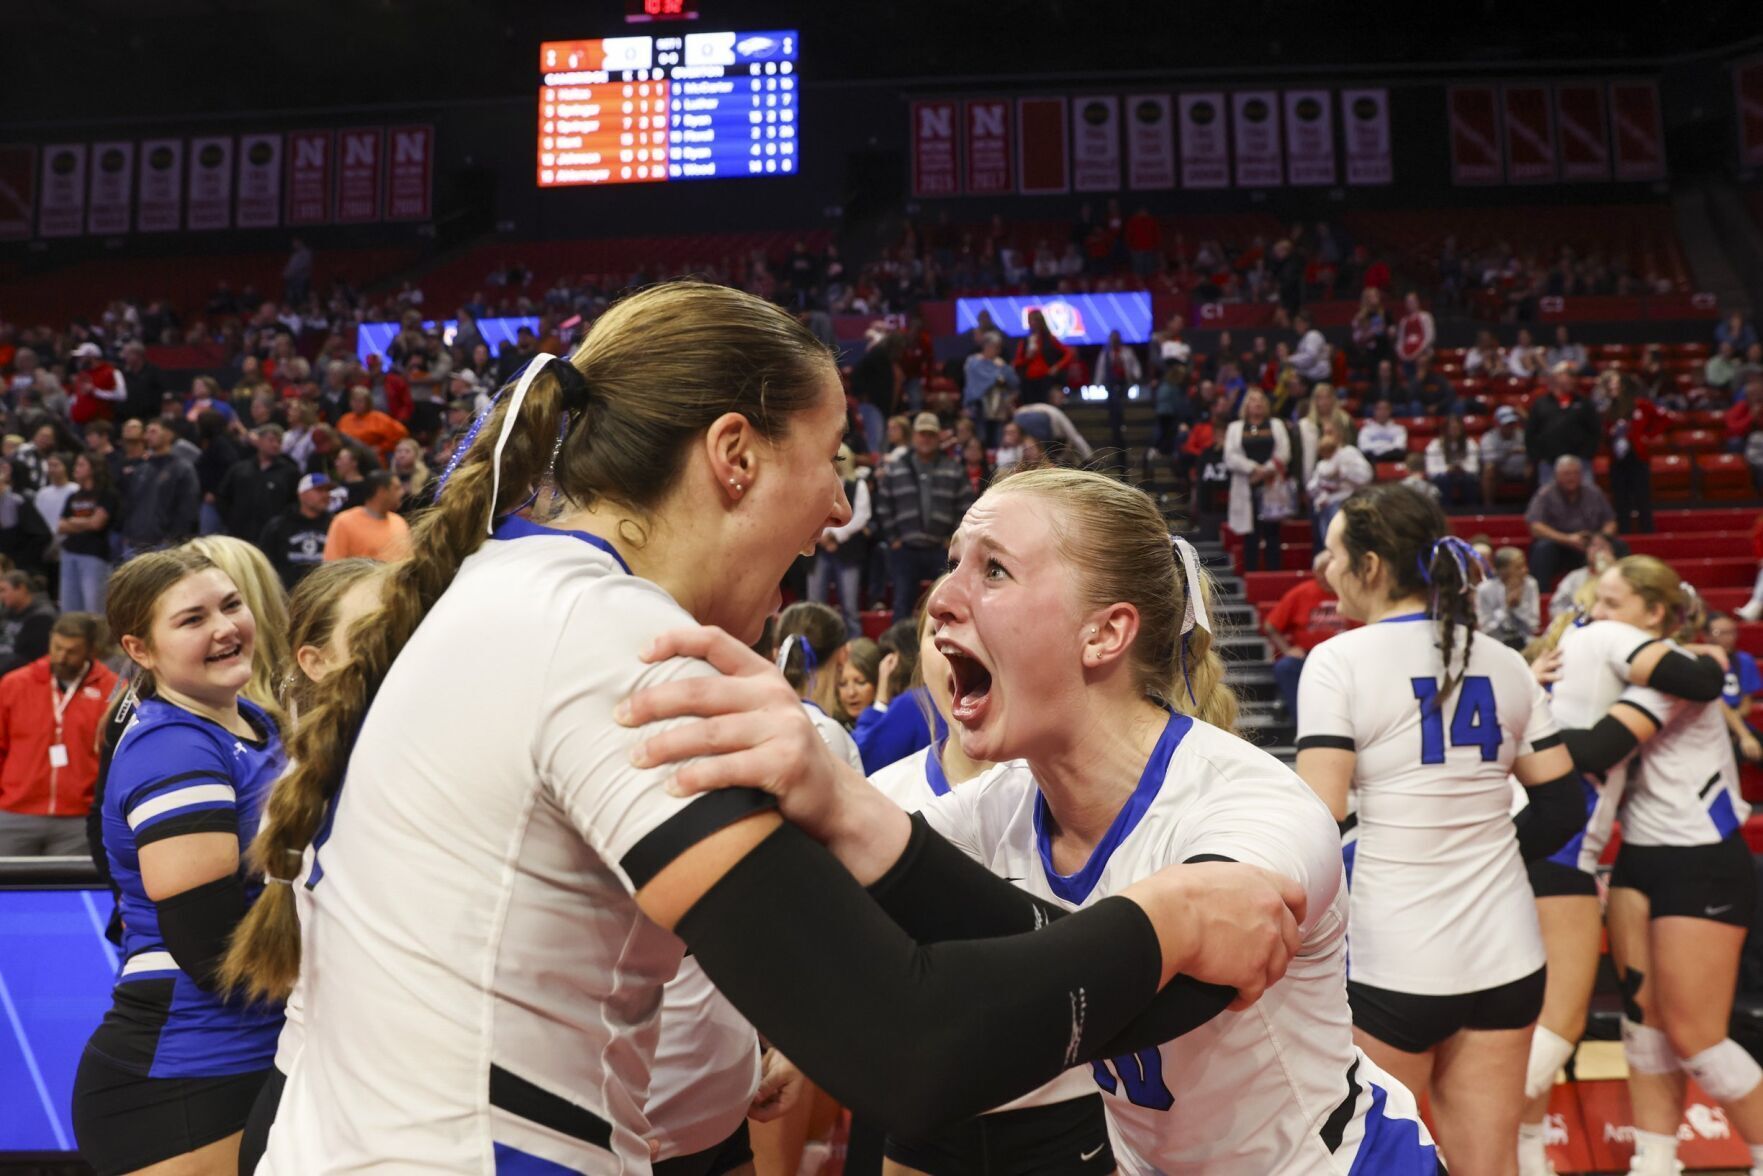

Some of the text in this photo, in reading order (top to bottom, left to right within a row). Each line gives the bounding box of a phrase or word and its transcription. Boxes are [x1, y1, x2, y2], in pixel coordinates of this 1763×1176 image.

[919, 106, 952, 138] N
[971, 104, 1005, 136] N
[295, 138, 325, 167] N
[345, 134, 376, 165] N
[395, 131, 425, 161] N
[1411, 676, 1503, 764] 14
